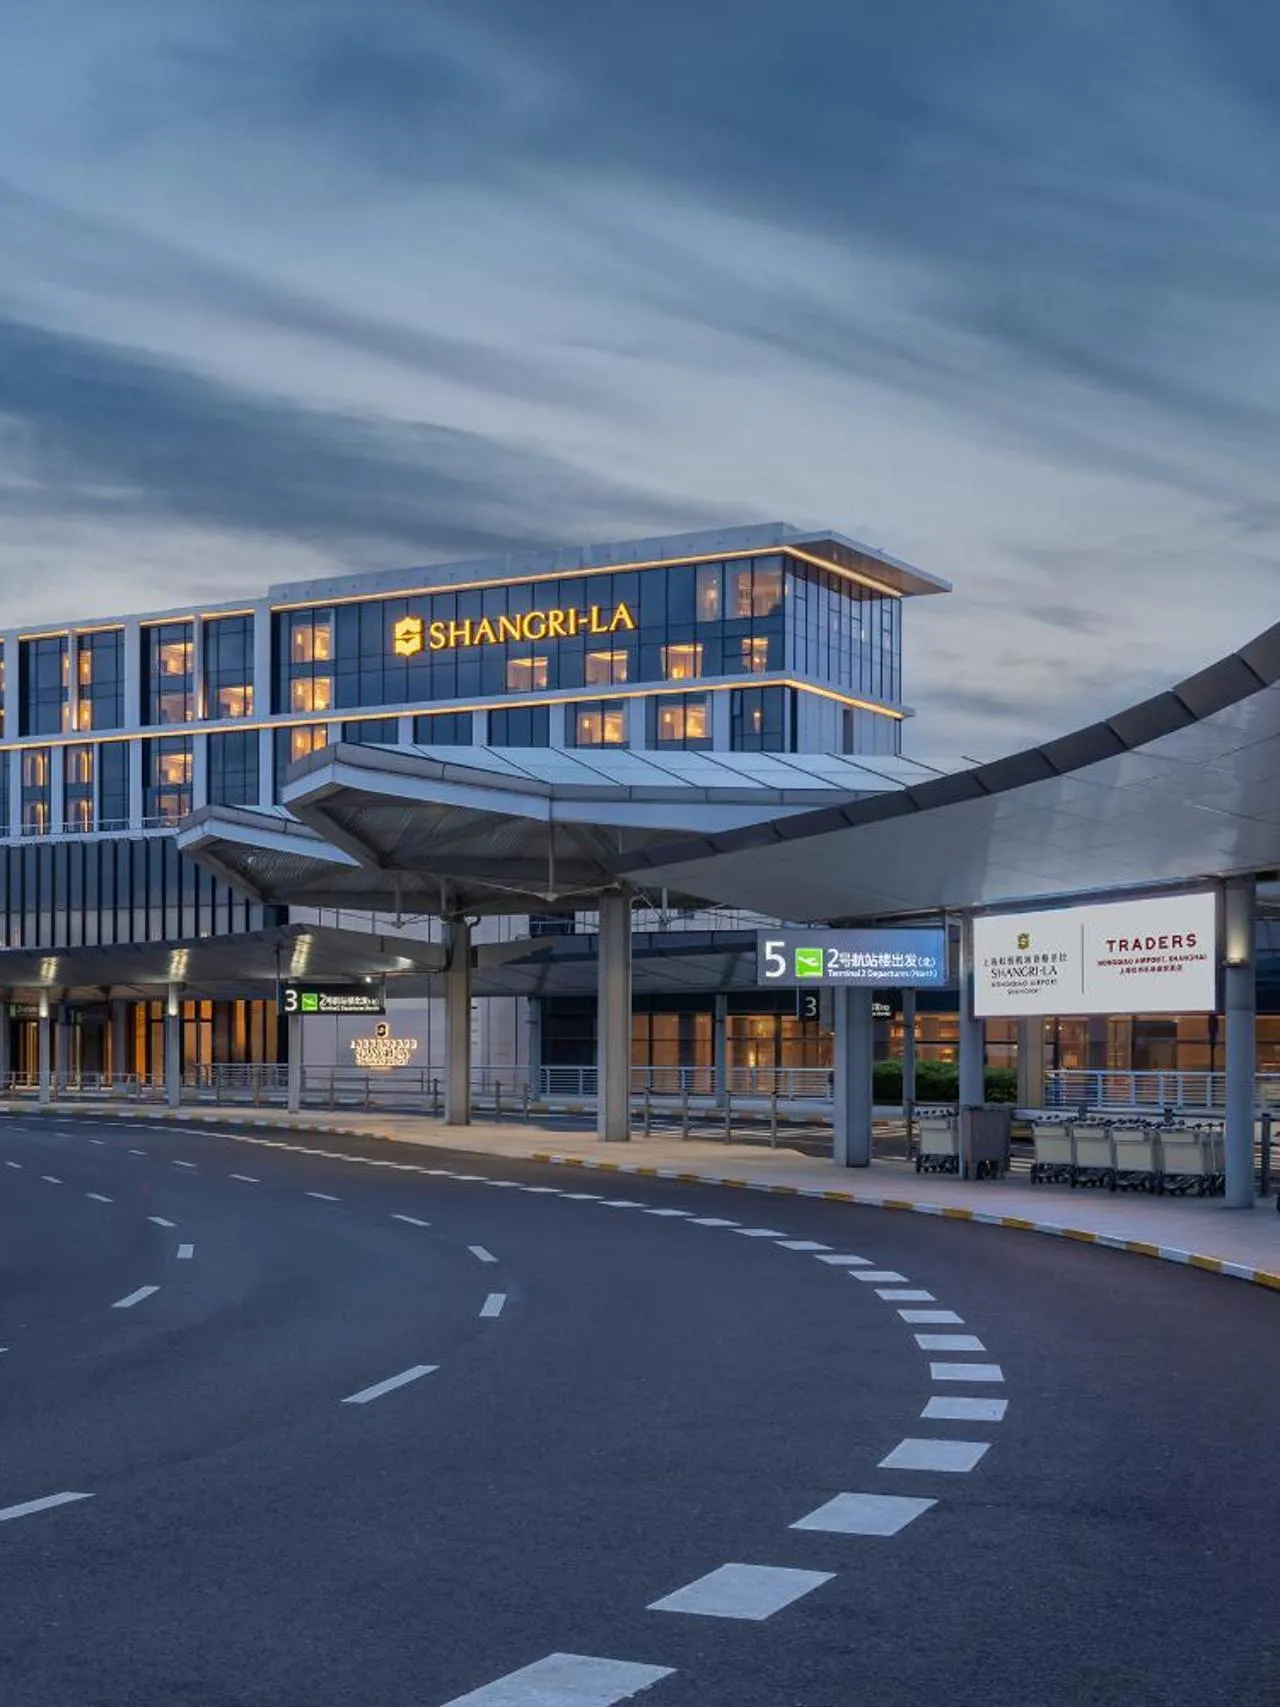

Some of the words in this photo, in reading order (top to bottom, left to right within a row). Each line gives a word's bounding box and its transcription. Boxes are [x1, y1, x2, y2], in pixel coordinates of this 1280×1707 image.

[429, 602, 635, 650] SHANGRI-LA
[1106, 933, 1197, 952] TRADERS
[765, 941, 786, 978] 5
[991, 965, 1057, 979] SHANGRI-LA
[284, 989, 298, 1012] 3
[805, 997, 817, 1017] 3
